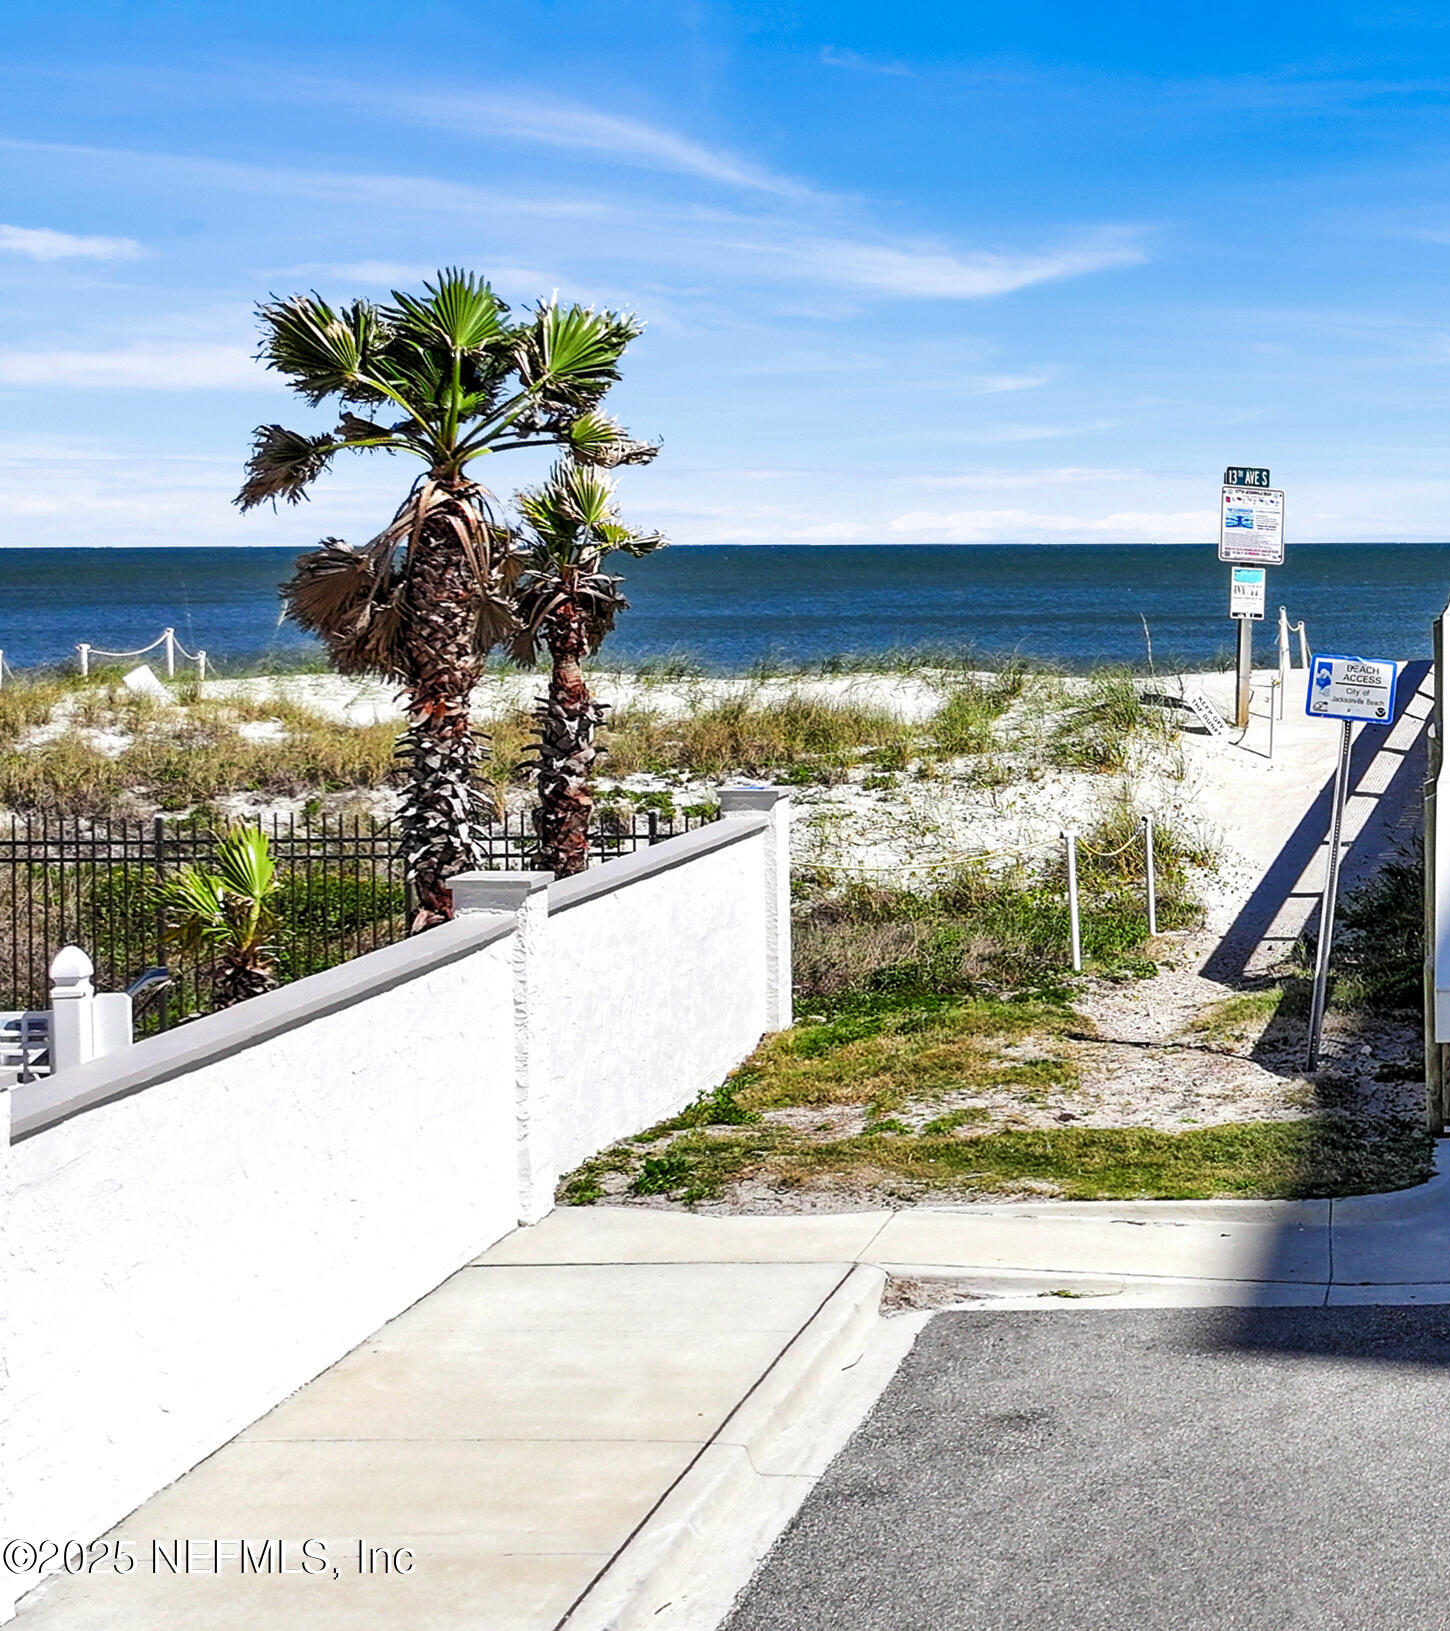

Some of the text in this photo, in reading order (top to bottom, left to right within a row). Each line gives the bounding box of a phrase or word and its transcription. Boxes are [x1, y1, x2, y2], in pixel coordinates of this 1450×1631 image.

[1244, 470, 1260, 485] AVE
[1261, 471, 1268, 486] S
[1346, 664, 1380, 675] BEACH
[1343, 674, 1382, 684] ACCESS
[1345, 687, 1370, 696] City of
[1332, 696, 1385, 706] Jacksonville Beach
